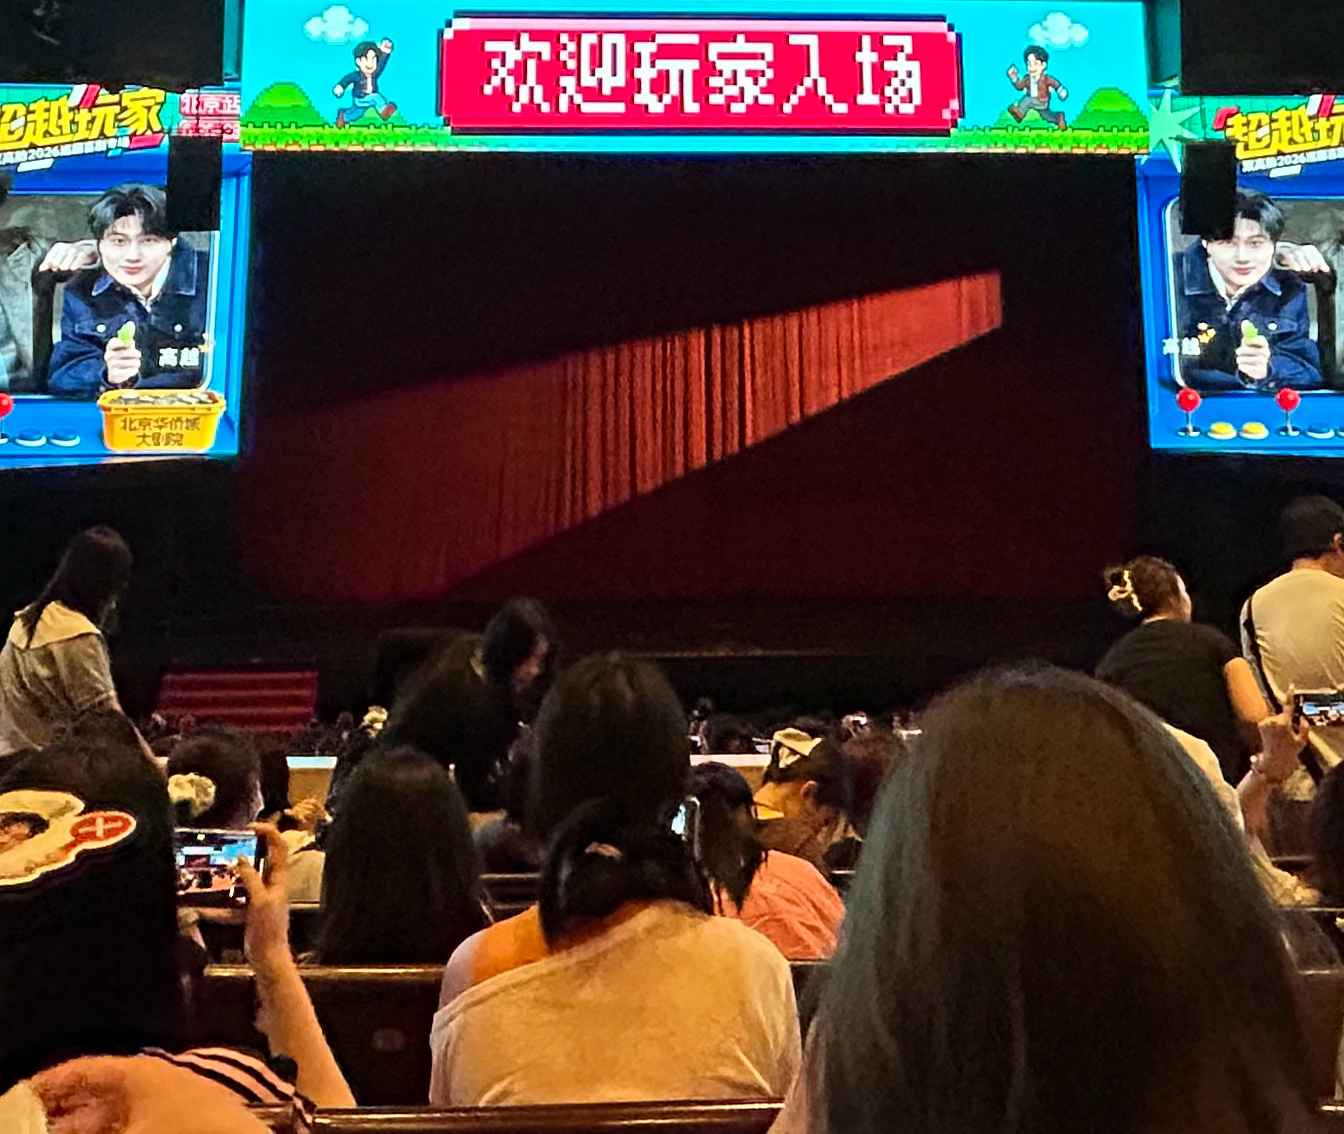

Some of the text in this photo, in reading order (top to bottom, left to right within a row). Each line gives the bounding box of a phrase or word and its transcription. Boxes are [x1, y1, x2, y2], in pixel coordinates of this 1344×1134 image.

[483, 32, 923, 114] 欢迎玩家入场
